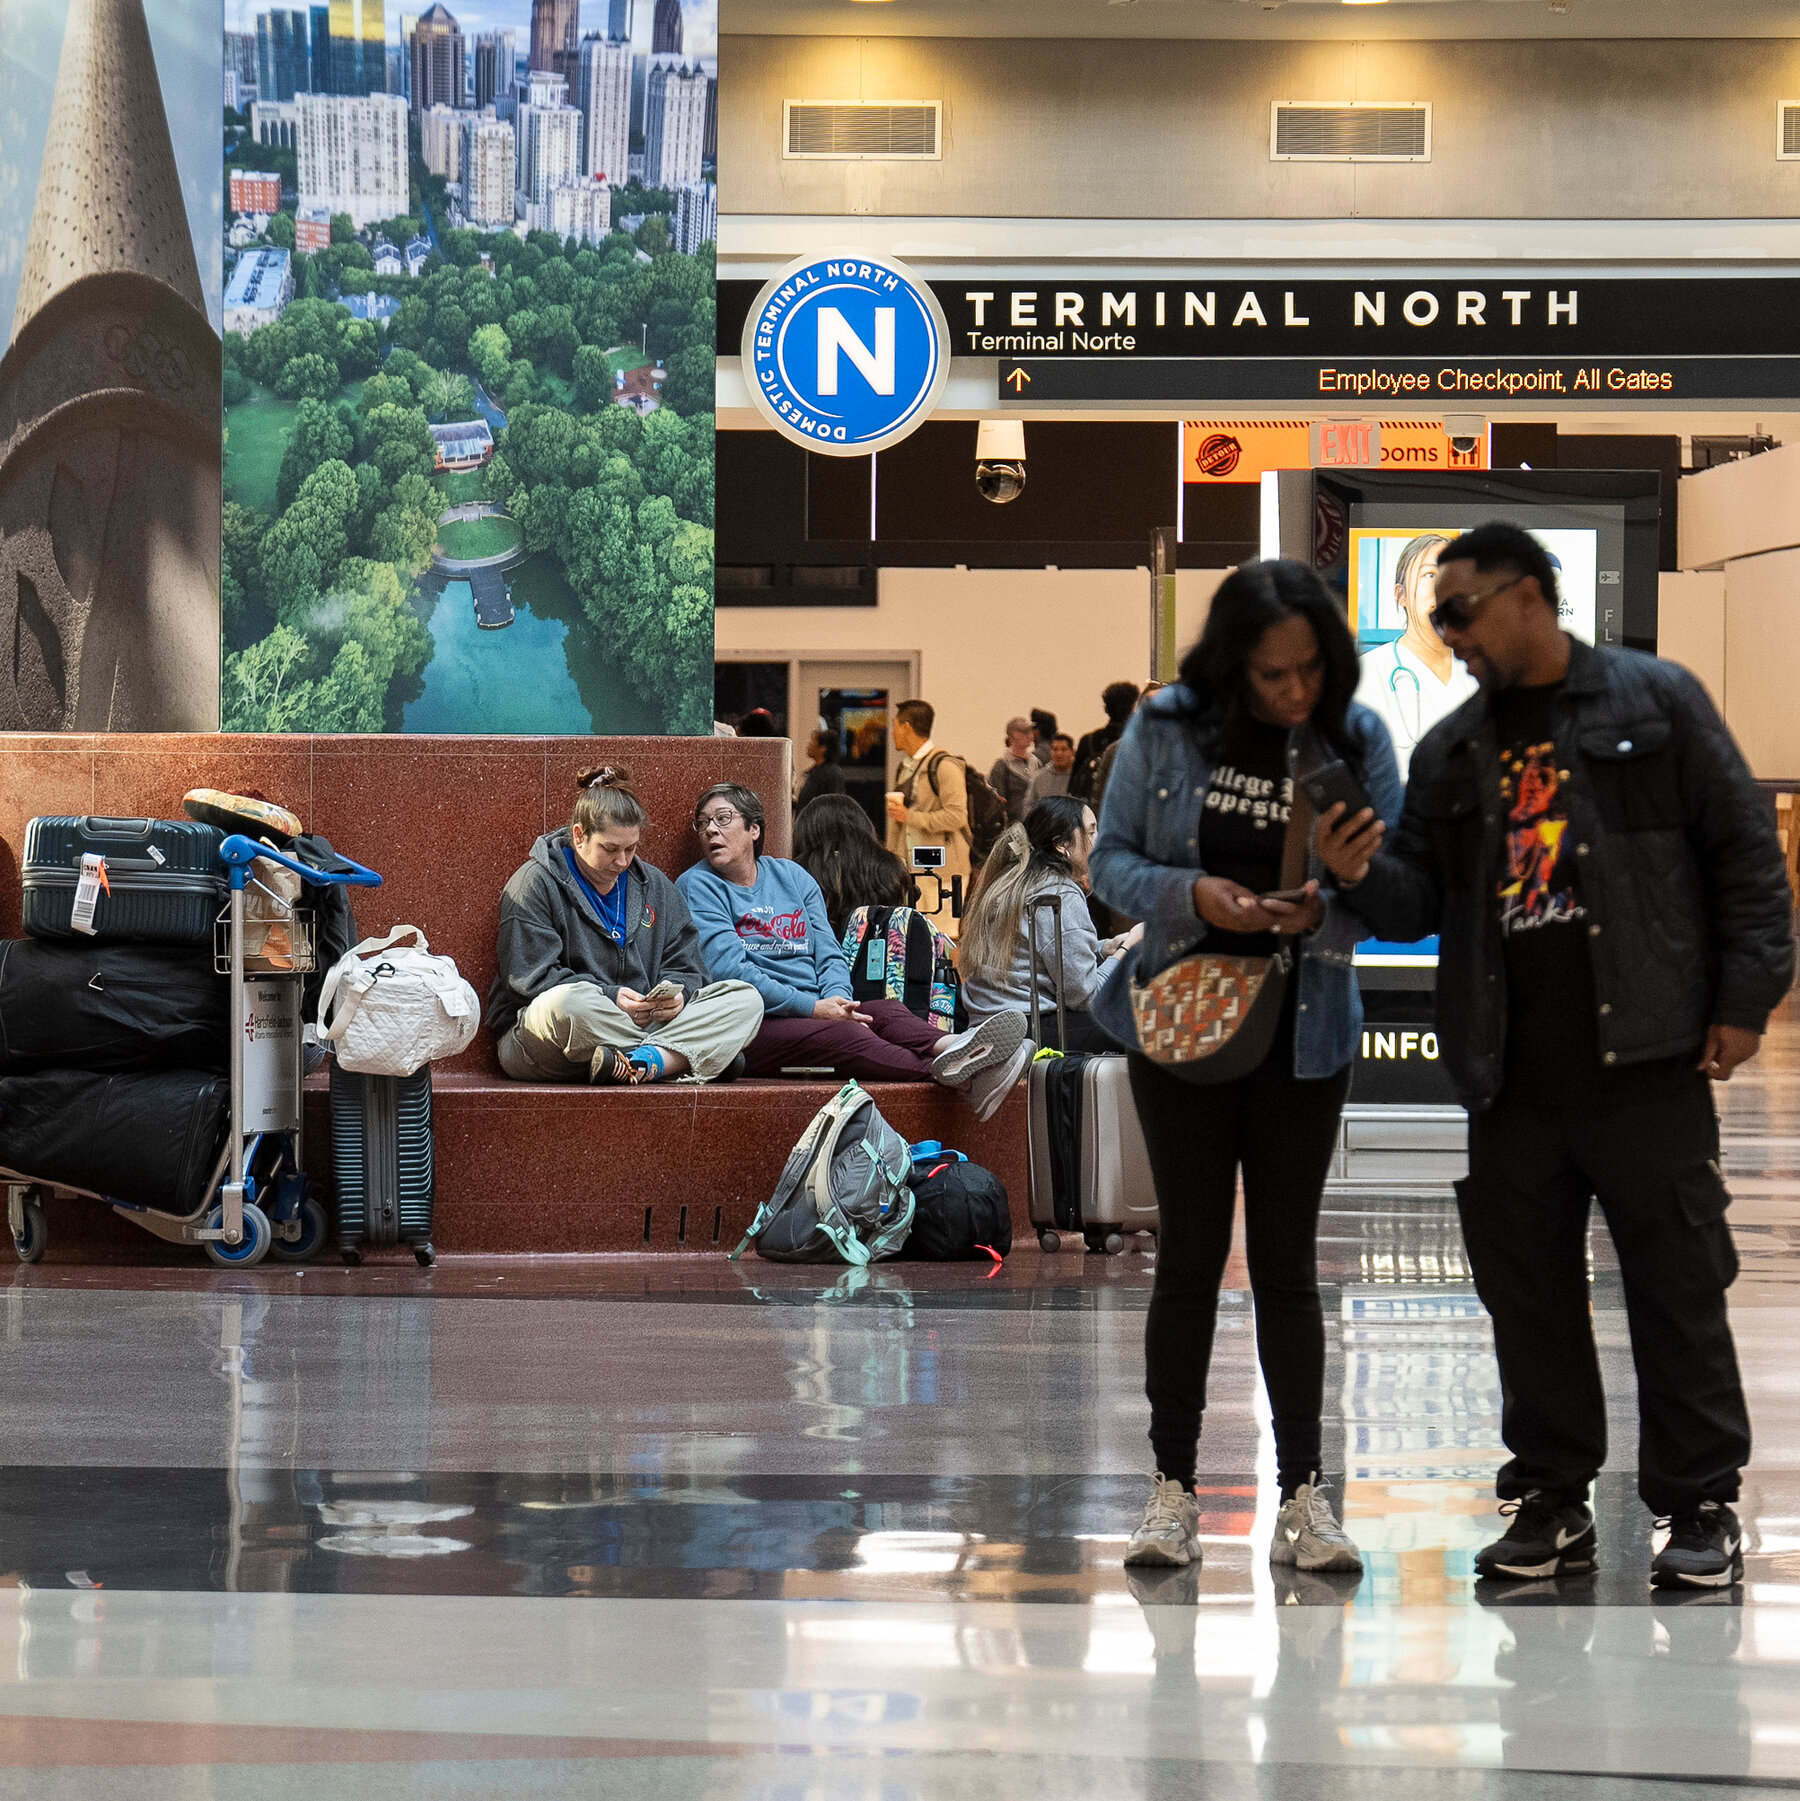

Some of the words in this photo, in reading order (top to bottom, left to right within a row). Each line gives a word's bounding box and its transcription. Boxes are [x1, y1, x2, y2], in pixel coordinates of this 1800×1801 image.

[826, 262, 899, 292] NORTH
[757, 270, 820, 361] TERMINAL
[965, 290, 1310, 327] TERMINAL
[1354, 290, 1579, 327] NORTH
[817, 307, 895, 396] N
[966, 331, 1064, 350] Terminal
[1073, 331, 1136, 350] Norte
[1319, 368, 1431, 395] Employee
[1437, 368, 1567, 395] Checkpoint,
[1574, 368, 1601, 390] All
[1607, 368, 1673, 390] Gates
[760, 369, 847, 440] DOMESTIC
[1200, 442, 1238, 468] DETOUR
[1320, 424, 1372, 465] EXIT
[1362, 1031, 1439, 1060] INFO
